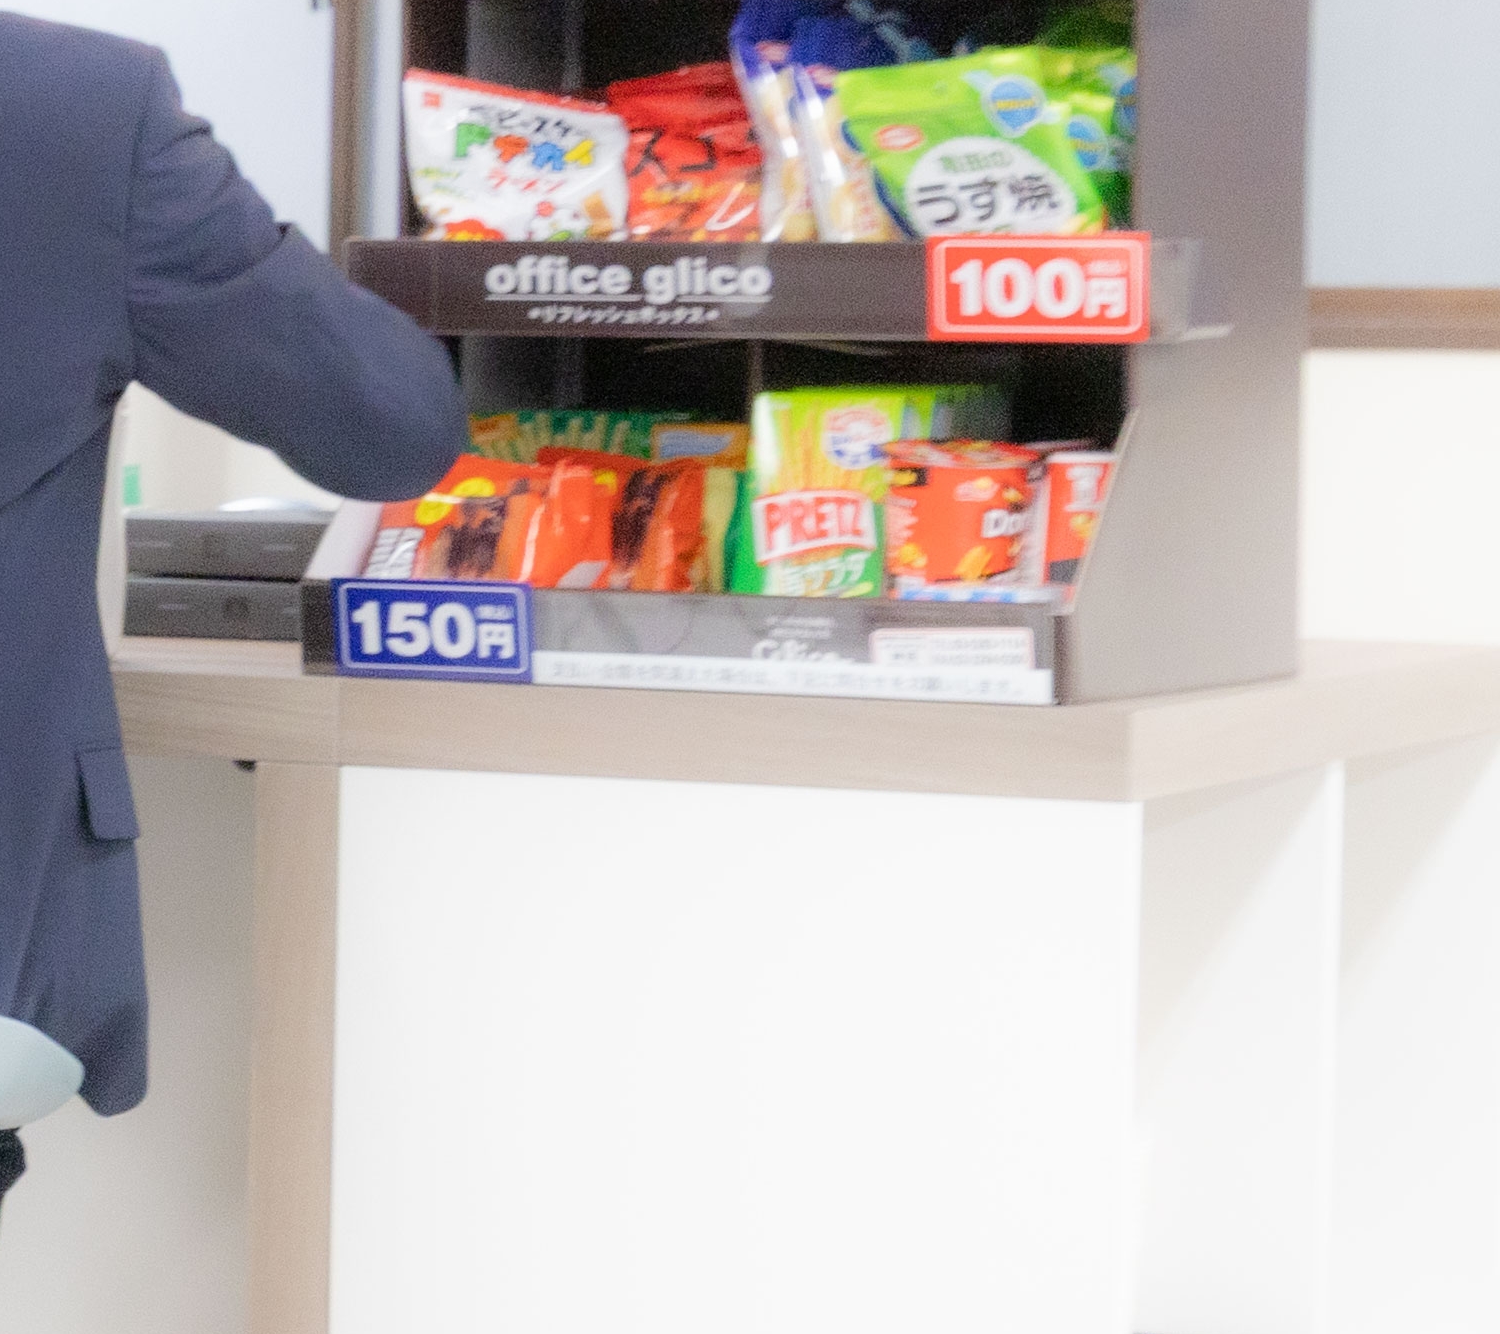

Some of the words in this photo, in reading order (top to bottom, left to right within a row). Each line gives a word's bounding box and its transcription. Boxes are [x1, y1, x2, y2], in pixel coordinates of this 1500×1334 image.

[485, 254, 632, 295] office
[642, 255, 773, 305] glico
[949, 257, 1128, 319] 100円
[764, 497, 864, 552] PRETZ
[352, 600, 516, 660] 150円
